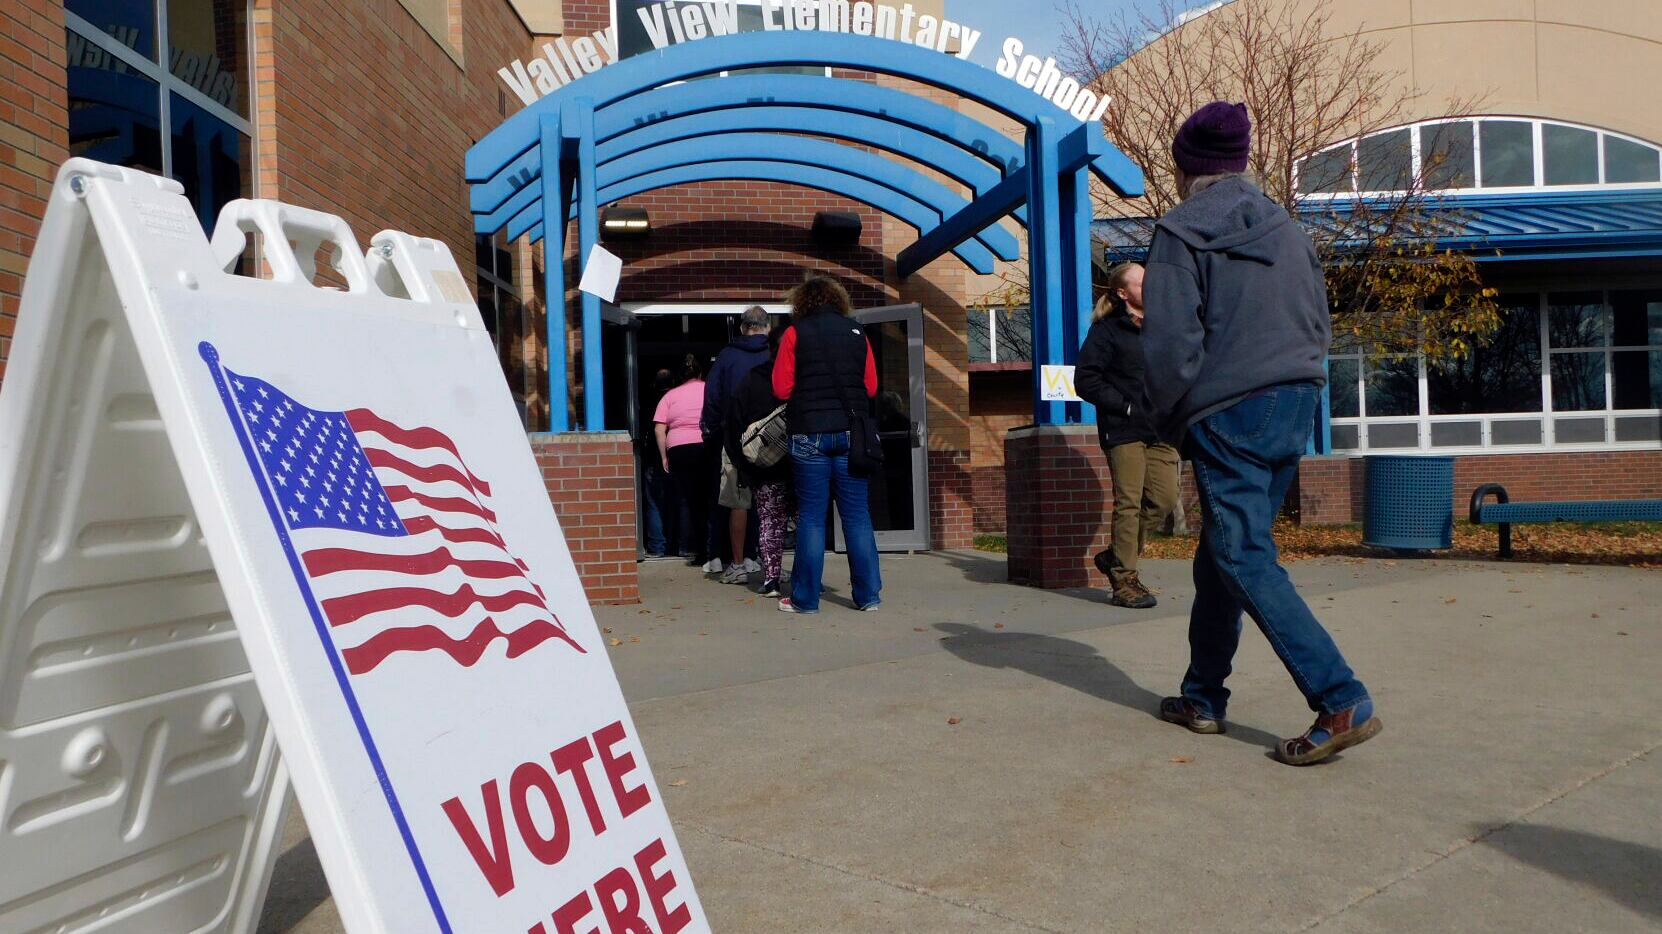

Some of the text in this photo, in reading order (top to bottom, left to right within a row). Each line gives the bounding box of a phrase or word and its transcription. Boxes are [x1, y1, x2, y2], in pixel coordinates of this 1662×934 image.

[497, 0, 1112, 122] Valley View Elementary School
[441, 720, 651, 898] VOTE
[527, 837, 692, 934] RE
